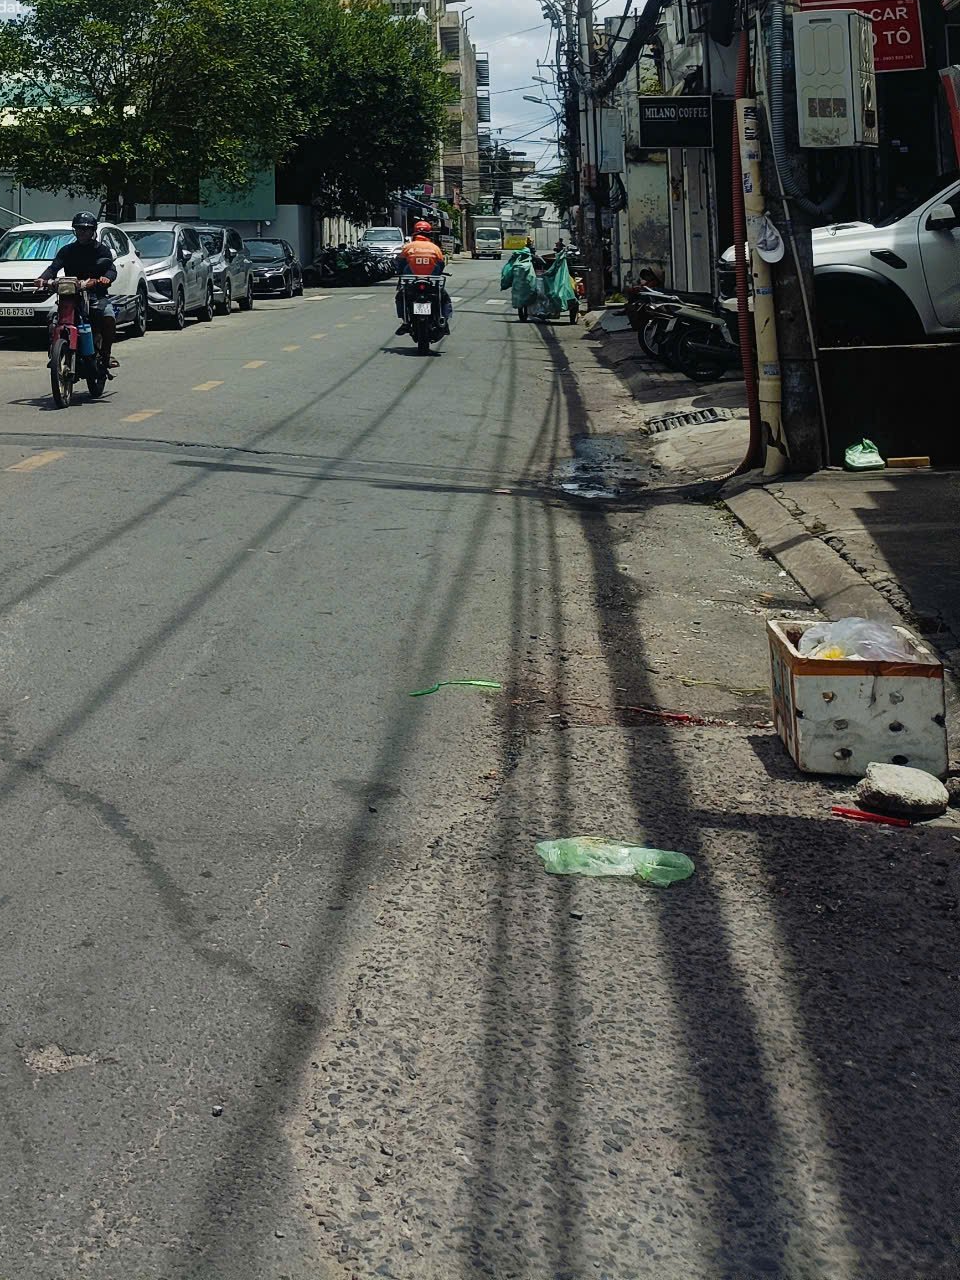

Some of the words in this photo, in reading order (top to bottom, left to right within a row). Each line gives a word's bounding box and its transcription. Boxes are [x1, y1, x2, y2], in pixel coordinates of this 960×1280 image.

[871, 6, 909, 22] CAR
[882, 26, 911, 45] TÔ
[645, 107, 676, 118] MILANO
[678, 107, 709, 118] COFFEE
